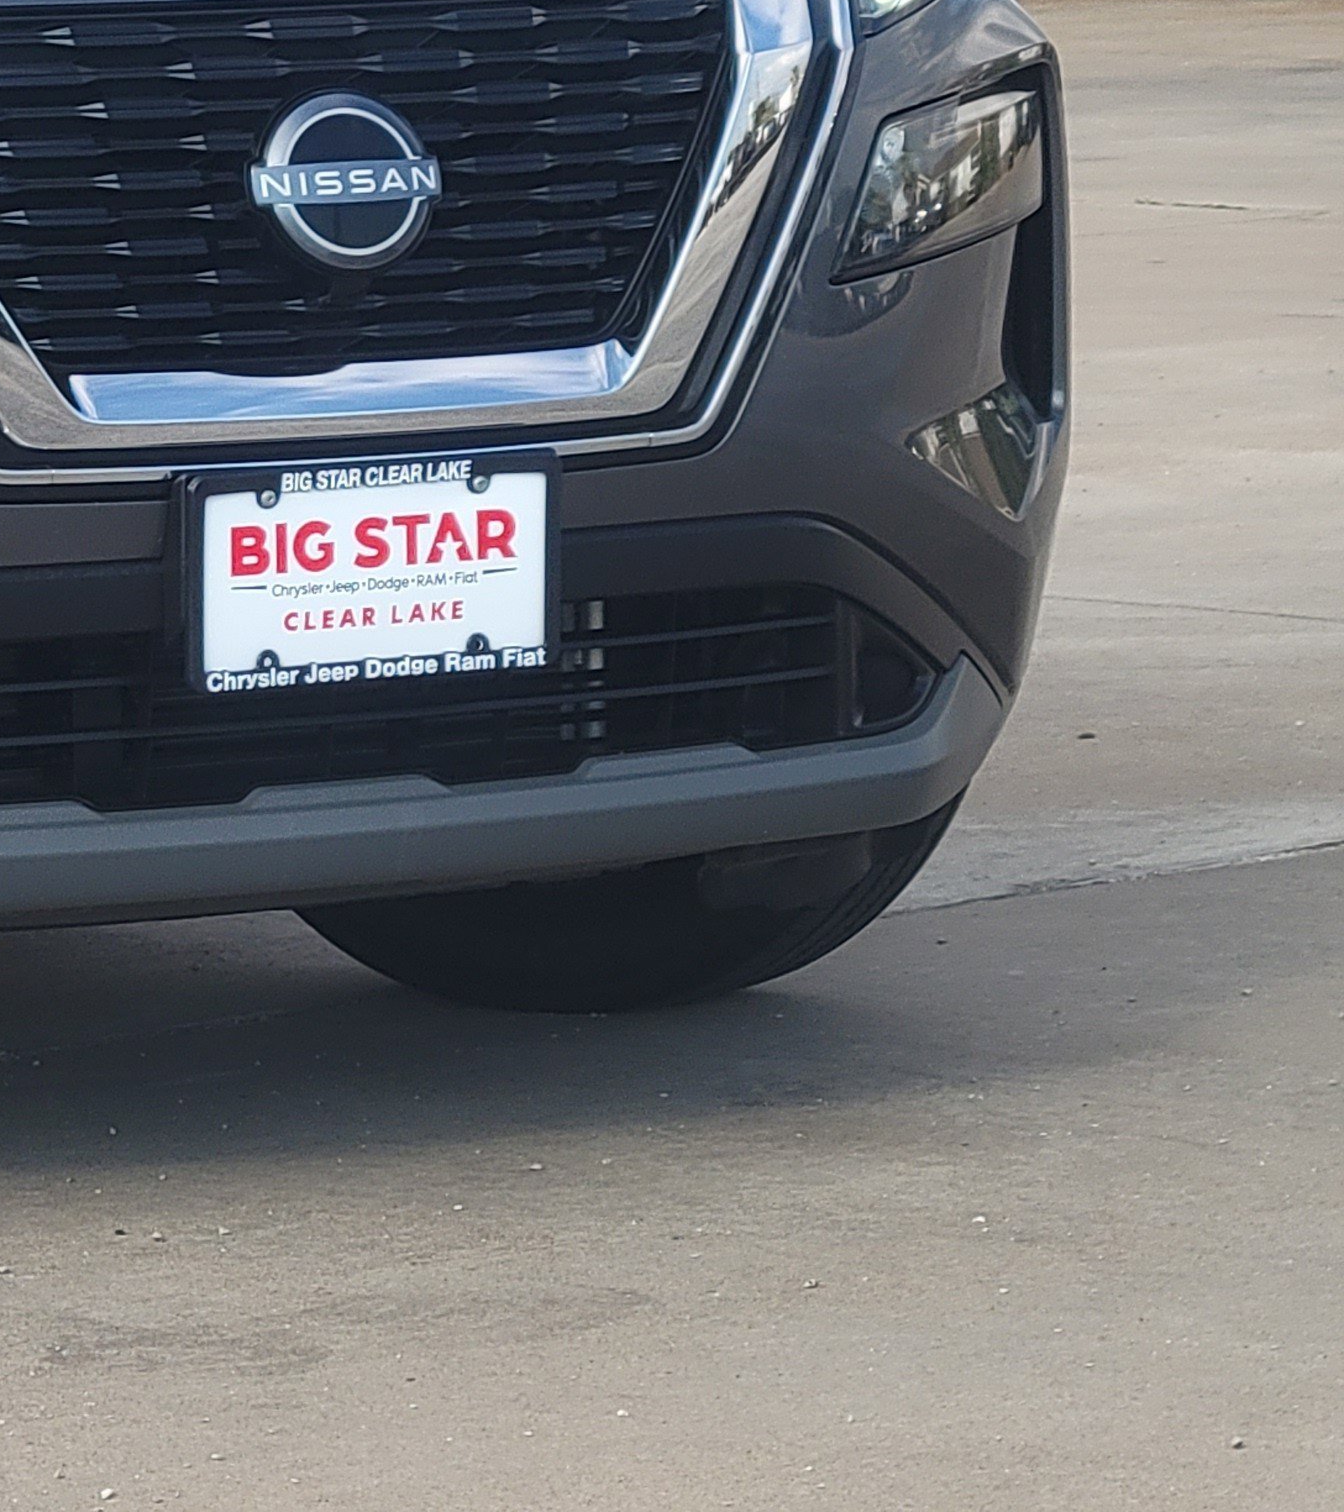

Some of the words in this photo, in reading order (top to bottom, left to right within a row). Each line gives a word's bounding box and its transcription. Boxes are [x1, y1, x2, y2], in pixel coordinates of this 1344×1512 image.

[260, 165, 437, 198] NISSAN
[280, 471, 312, 493] BIG
[315, 469, 362, 491] STAR
[365, 465, 424, 487] CLEAR
[426, 459, 472, 482] LAKE
[230, 519, 335, 578] BIG
[354, 509, 518, 569] STAR
[283, 606, 377, 632] CLEAR
[391, 600, 464, 625] LAKE
[206, 667, 300, 693] Chrysler
[304, 663, 359, 688] Jeep
[364, 656, 438, 679] Dodge
[444, 650, 495, 672] Ram
[502, 646, 546, 668] Fiat
